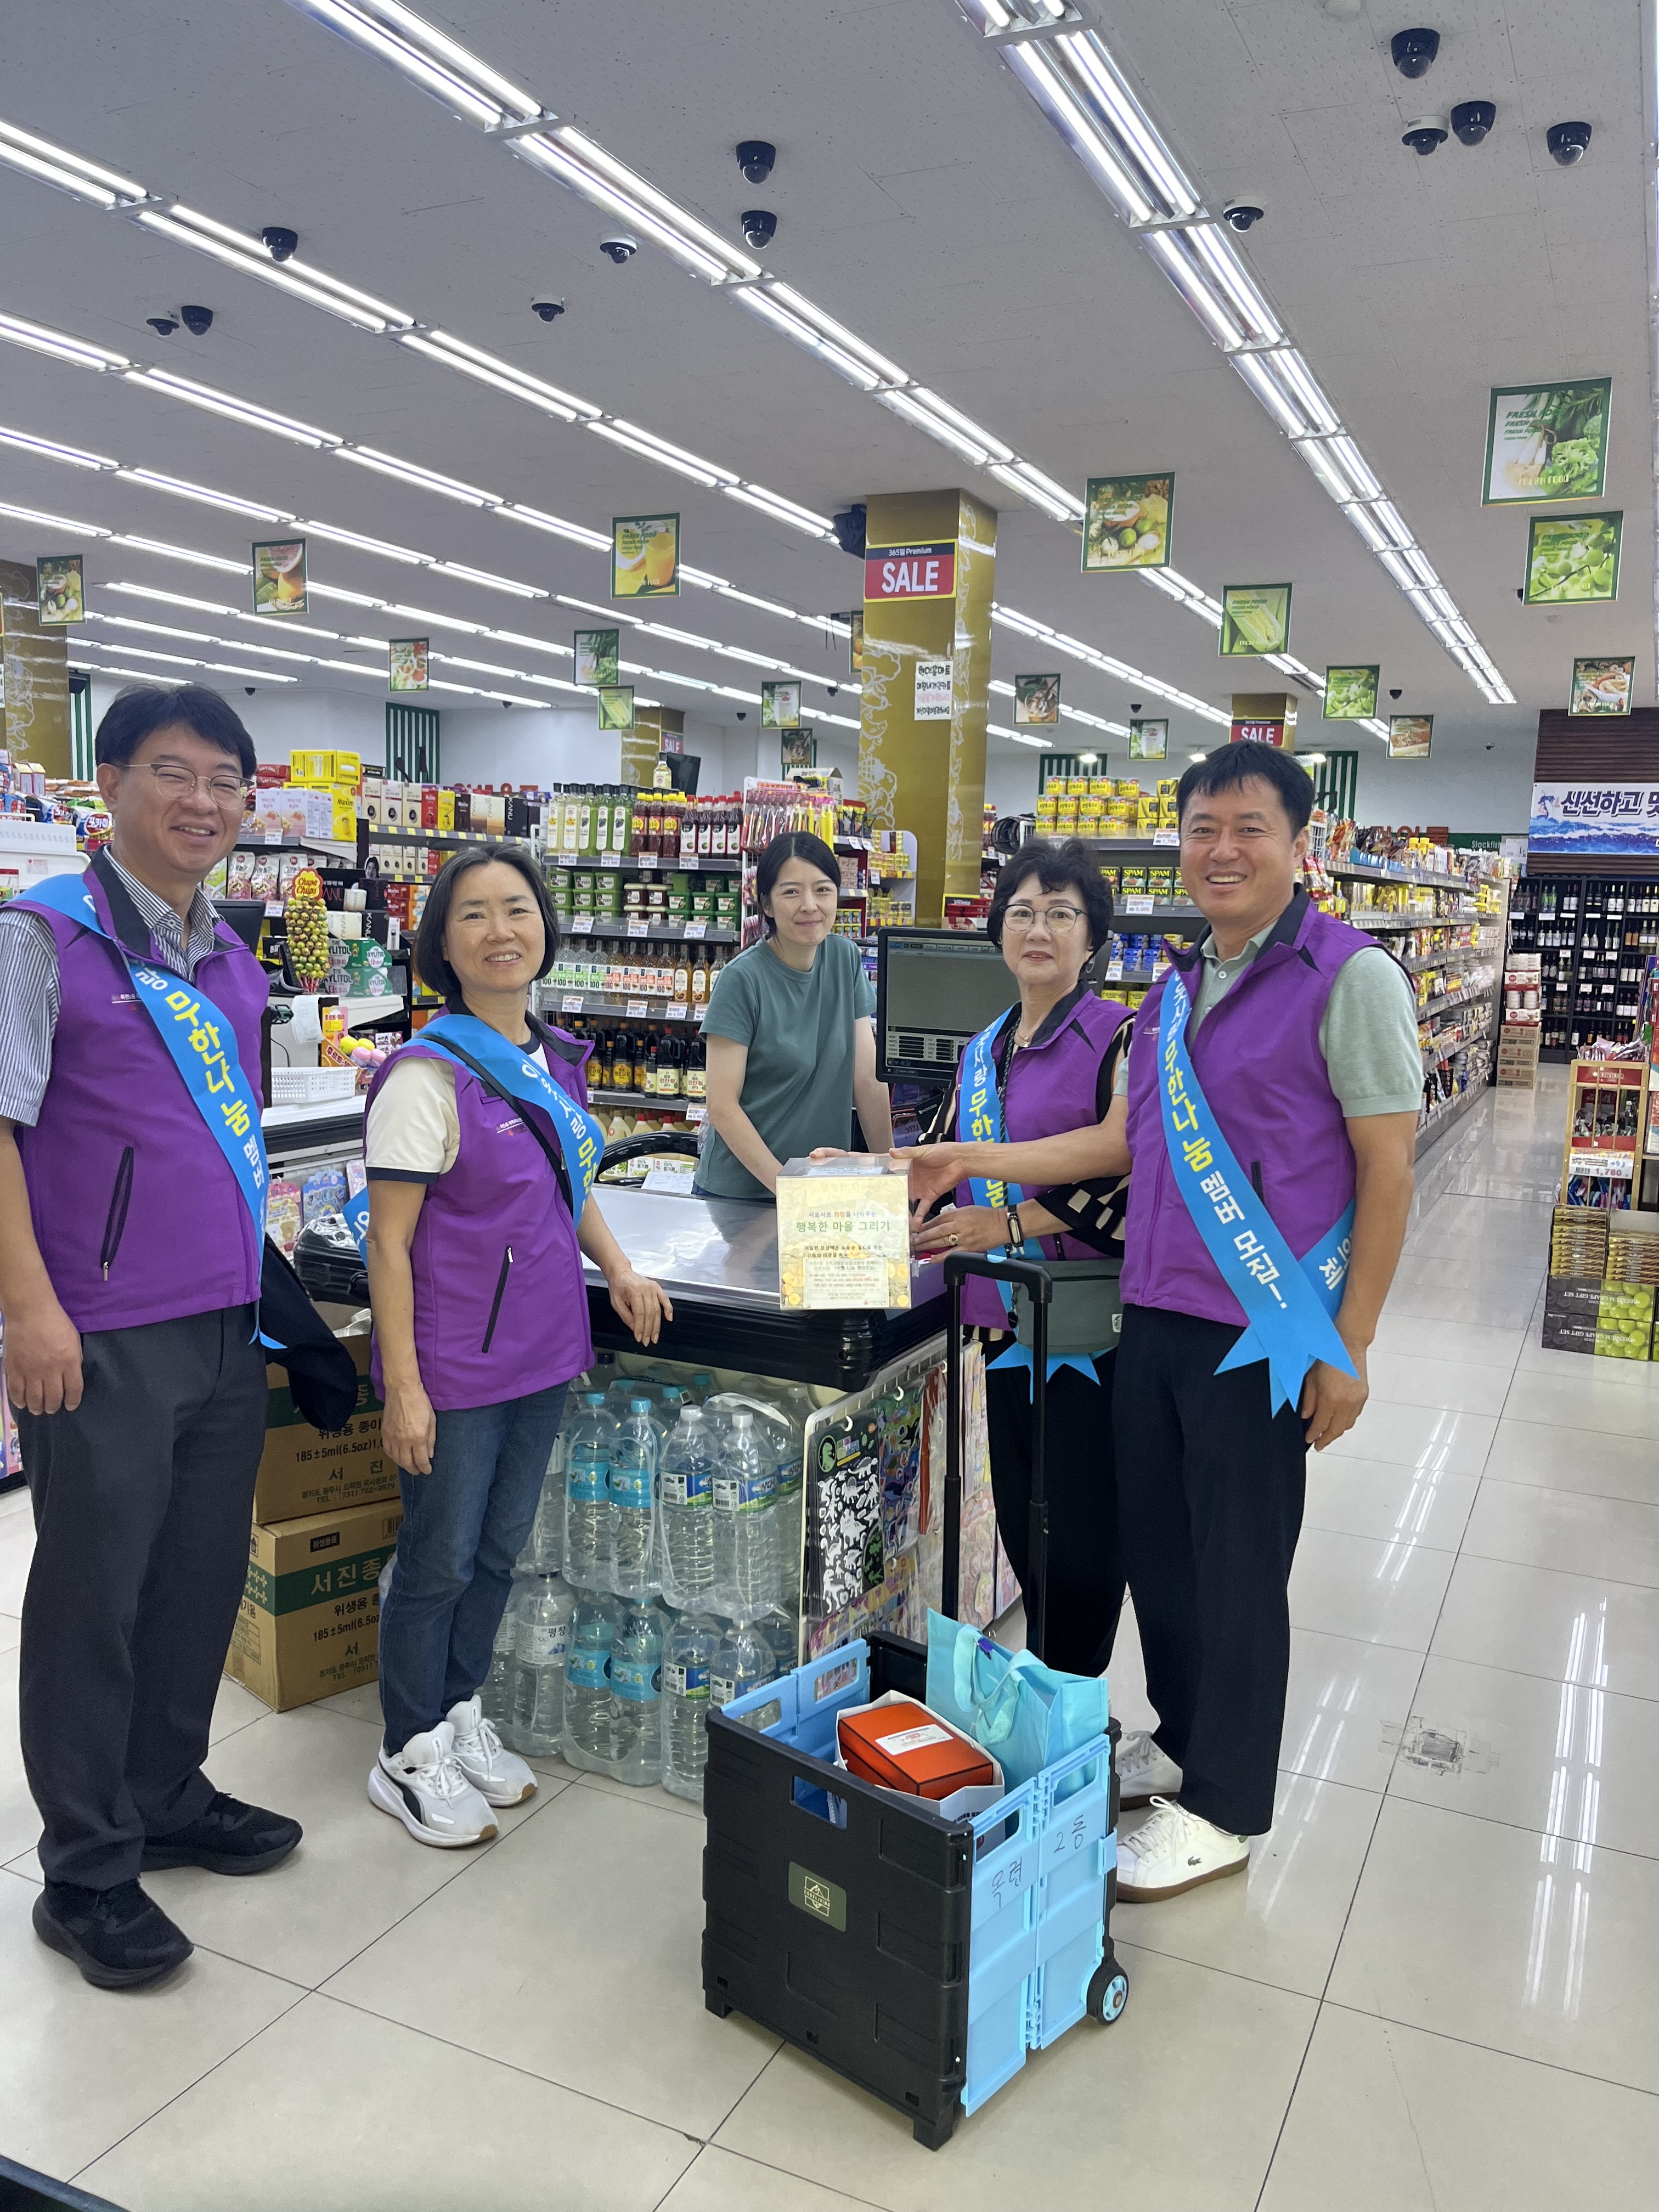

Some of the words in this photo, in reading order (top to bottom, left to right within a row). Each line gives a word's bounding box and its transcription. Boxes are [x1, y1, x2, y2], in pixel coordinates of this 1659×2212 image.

[1547, 475, 1569, 484] FOOD
[906, 547, 932, 555] Premium
[882, 561, 939, 593] SALE
[1241, 727, 1274, 744] SALE
[337, 798, 354, 806] Maxim
[1561, 791, 1645, 817] 신선하고
[298, 878, 317, 886] Chupa
[297, 886, 317, 895] Chups
[328, 946, 351, 955] YLITOL
[1595, 1168, 1622, 1176] 1,780
[796, 1221, 828, 1233] 행복한
[833, 1221, 854, 1232] 마을
[859, 1221, 889, 1232] 그리기
[302, 1489, 321, 1499] 경기도
[316, 1496, 331, 1504] TEL
[334, 1597, 367, 1616] 위생용
[548, 1624, 566, 1637] 평창
[333, 1673, 346, 1681] TEL
